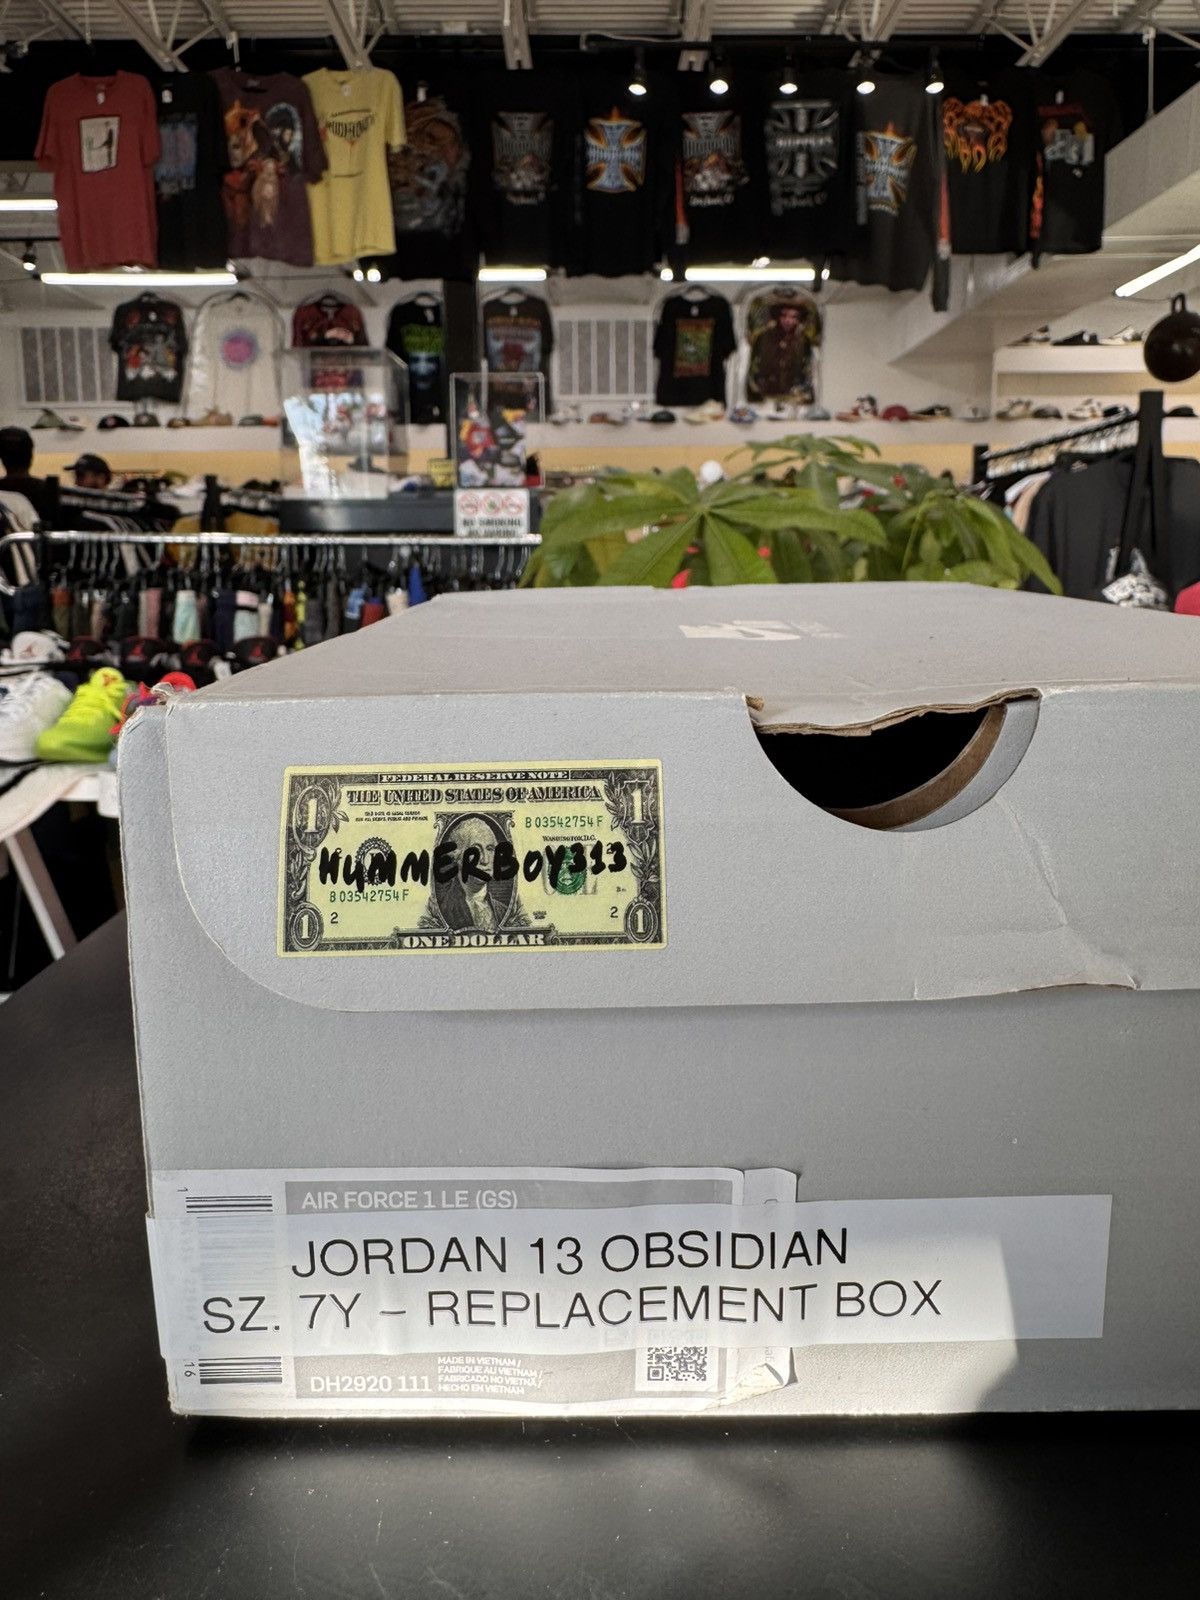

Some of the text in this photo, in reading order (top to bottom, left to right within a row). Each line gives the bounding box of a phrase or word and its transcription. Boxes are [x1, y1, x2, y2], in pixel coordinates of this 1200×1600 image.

[380, 771, 569, 783] FEDERAL RESERVE NOTE
[347, 785, 603, 805] THE UNITED STATES OF AMERICA
[330, 911, 339, 924] 2
[610, 906, 619, 919] 2
[403, 934, 545, 948] ONE DOLLAR
[302, 1189, 518, 1210] AIR FORCE 1 LE (GS)
[291, 1227, 848, 1278] JORDAN 13 OBSIDIAN
[203, 1295, 280, 1334] SZ.
[299, 1292, 362, 1330] 7Y
[428, 1283, 818, 1330] REPLACEMENT
[836, 1279, 942, 1319] BOX
[438, 1356, 464, 1365] MADE
[465, 1356, 475, 1365] IN
[476, 1357, 516, 1367] VIETNAM
[484, 1366, 497, 1375] AU
[498, 1368, 538, 1378] VIETNAM
[310, 1375, 432, 1393] DH2920 111
[438, 1375, 489, 1383] FABRICADO
[490, 1376, 503, 1384] NO
[438, 1384, 525, 1395] HECHO EN VIETNAM
